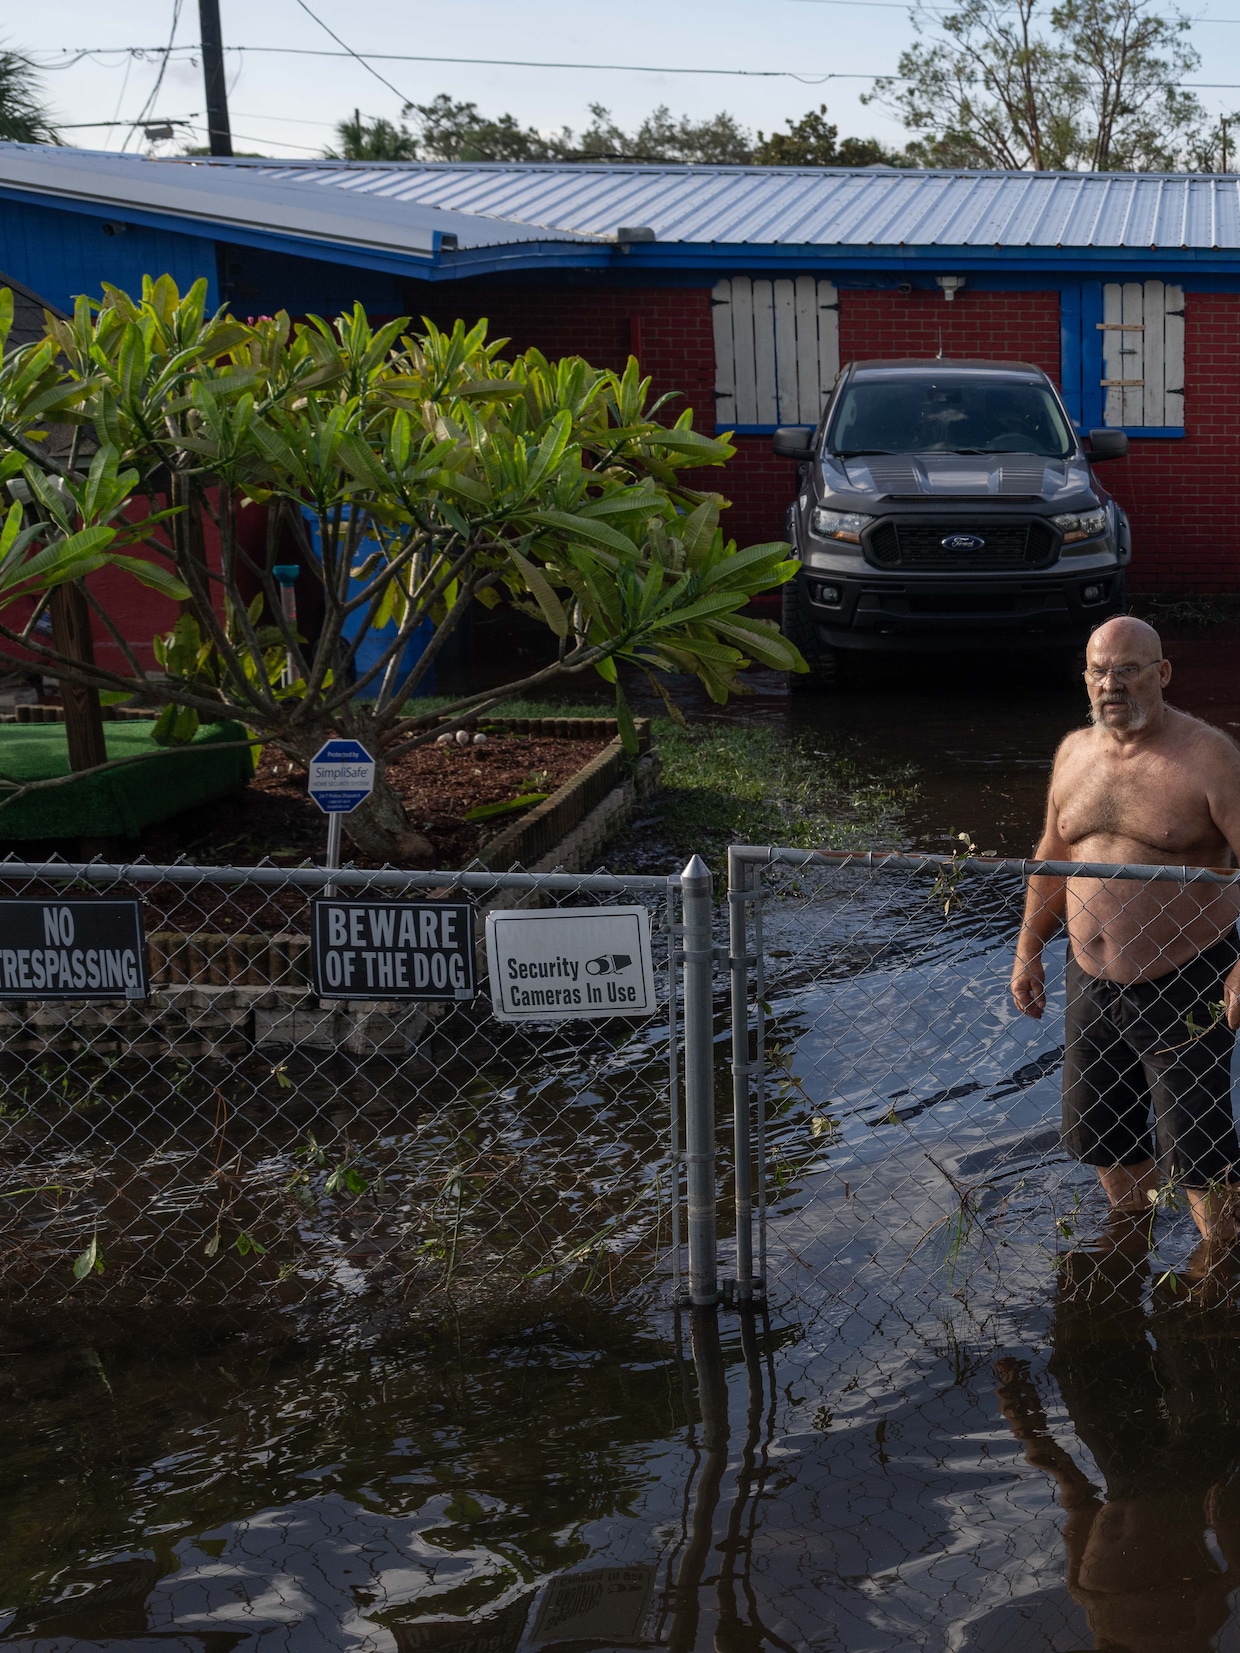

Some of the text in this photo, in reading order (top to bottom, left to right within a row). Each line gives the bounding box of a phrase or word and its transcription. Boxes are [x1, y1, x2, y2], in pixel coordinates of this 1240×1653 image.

[352, 751, 359, 759] by
[43, 906, 75, 946] NO
[328, 908, 459, 948] BEWARE
[0, 948, 138, 989] RESPASSING
[325, 950, 466, 989] OF THE DOG
[507, 956, 579, 981] Security
[510, 981, 636, 1006] Cameras In Use
